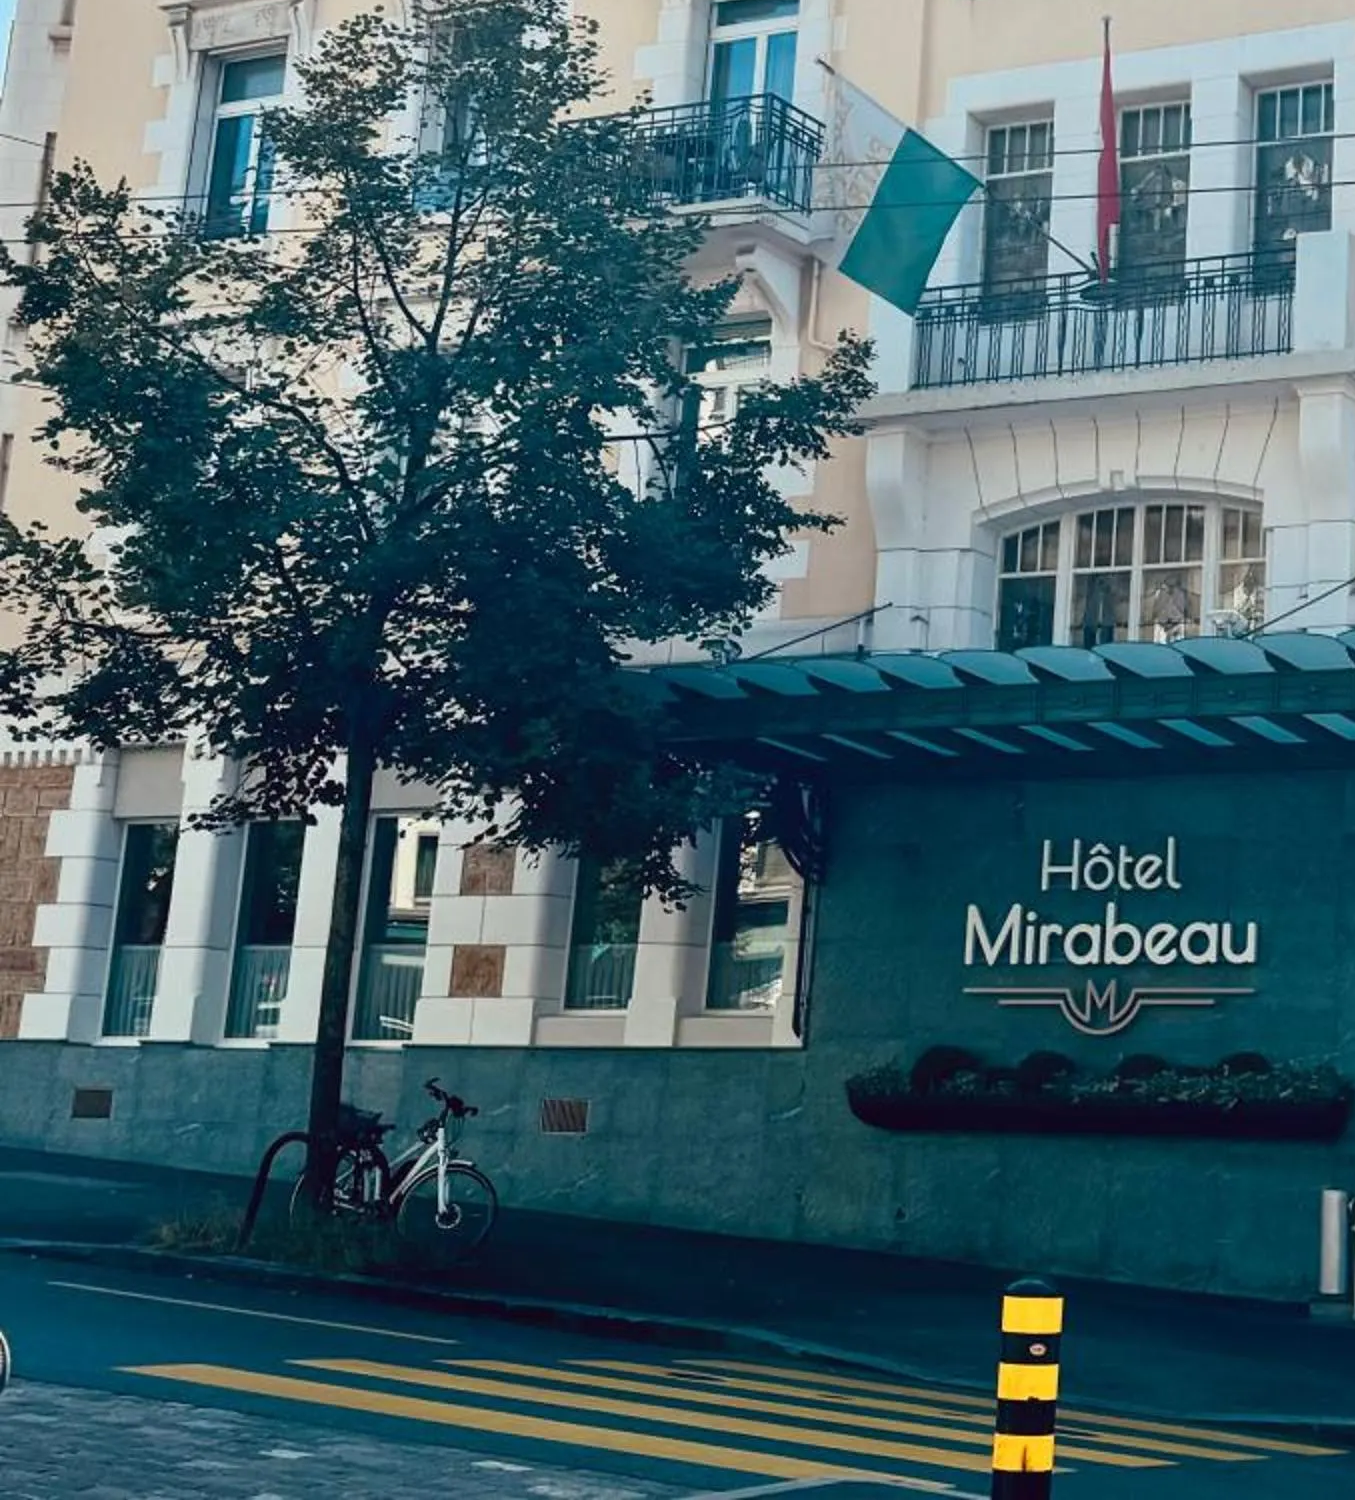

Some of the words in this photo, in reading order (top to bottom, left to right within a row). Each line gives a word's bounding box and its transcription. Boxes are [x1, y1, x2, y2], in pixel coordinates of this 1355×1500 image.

[1041, 836, 1181, 891] Hôtel
[964, 902, 1257, 966] Mirabeau
[1083, 978, 1118, 1022] M
